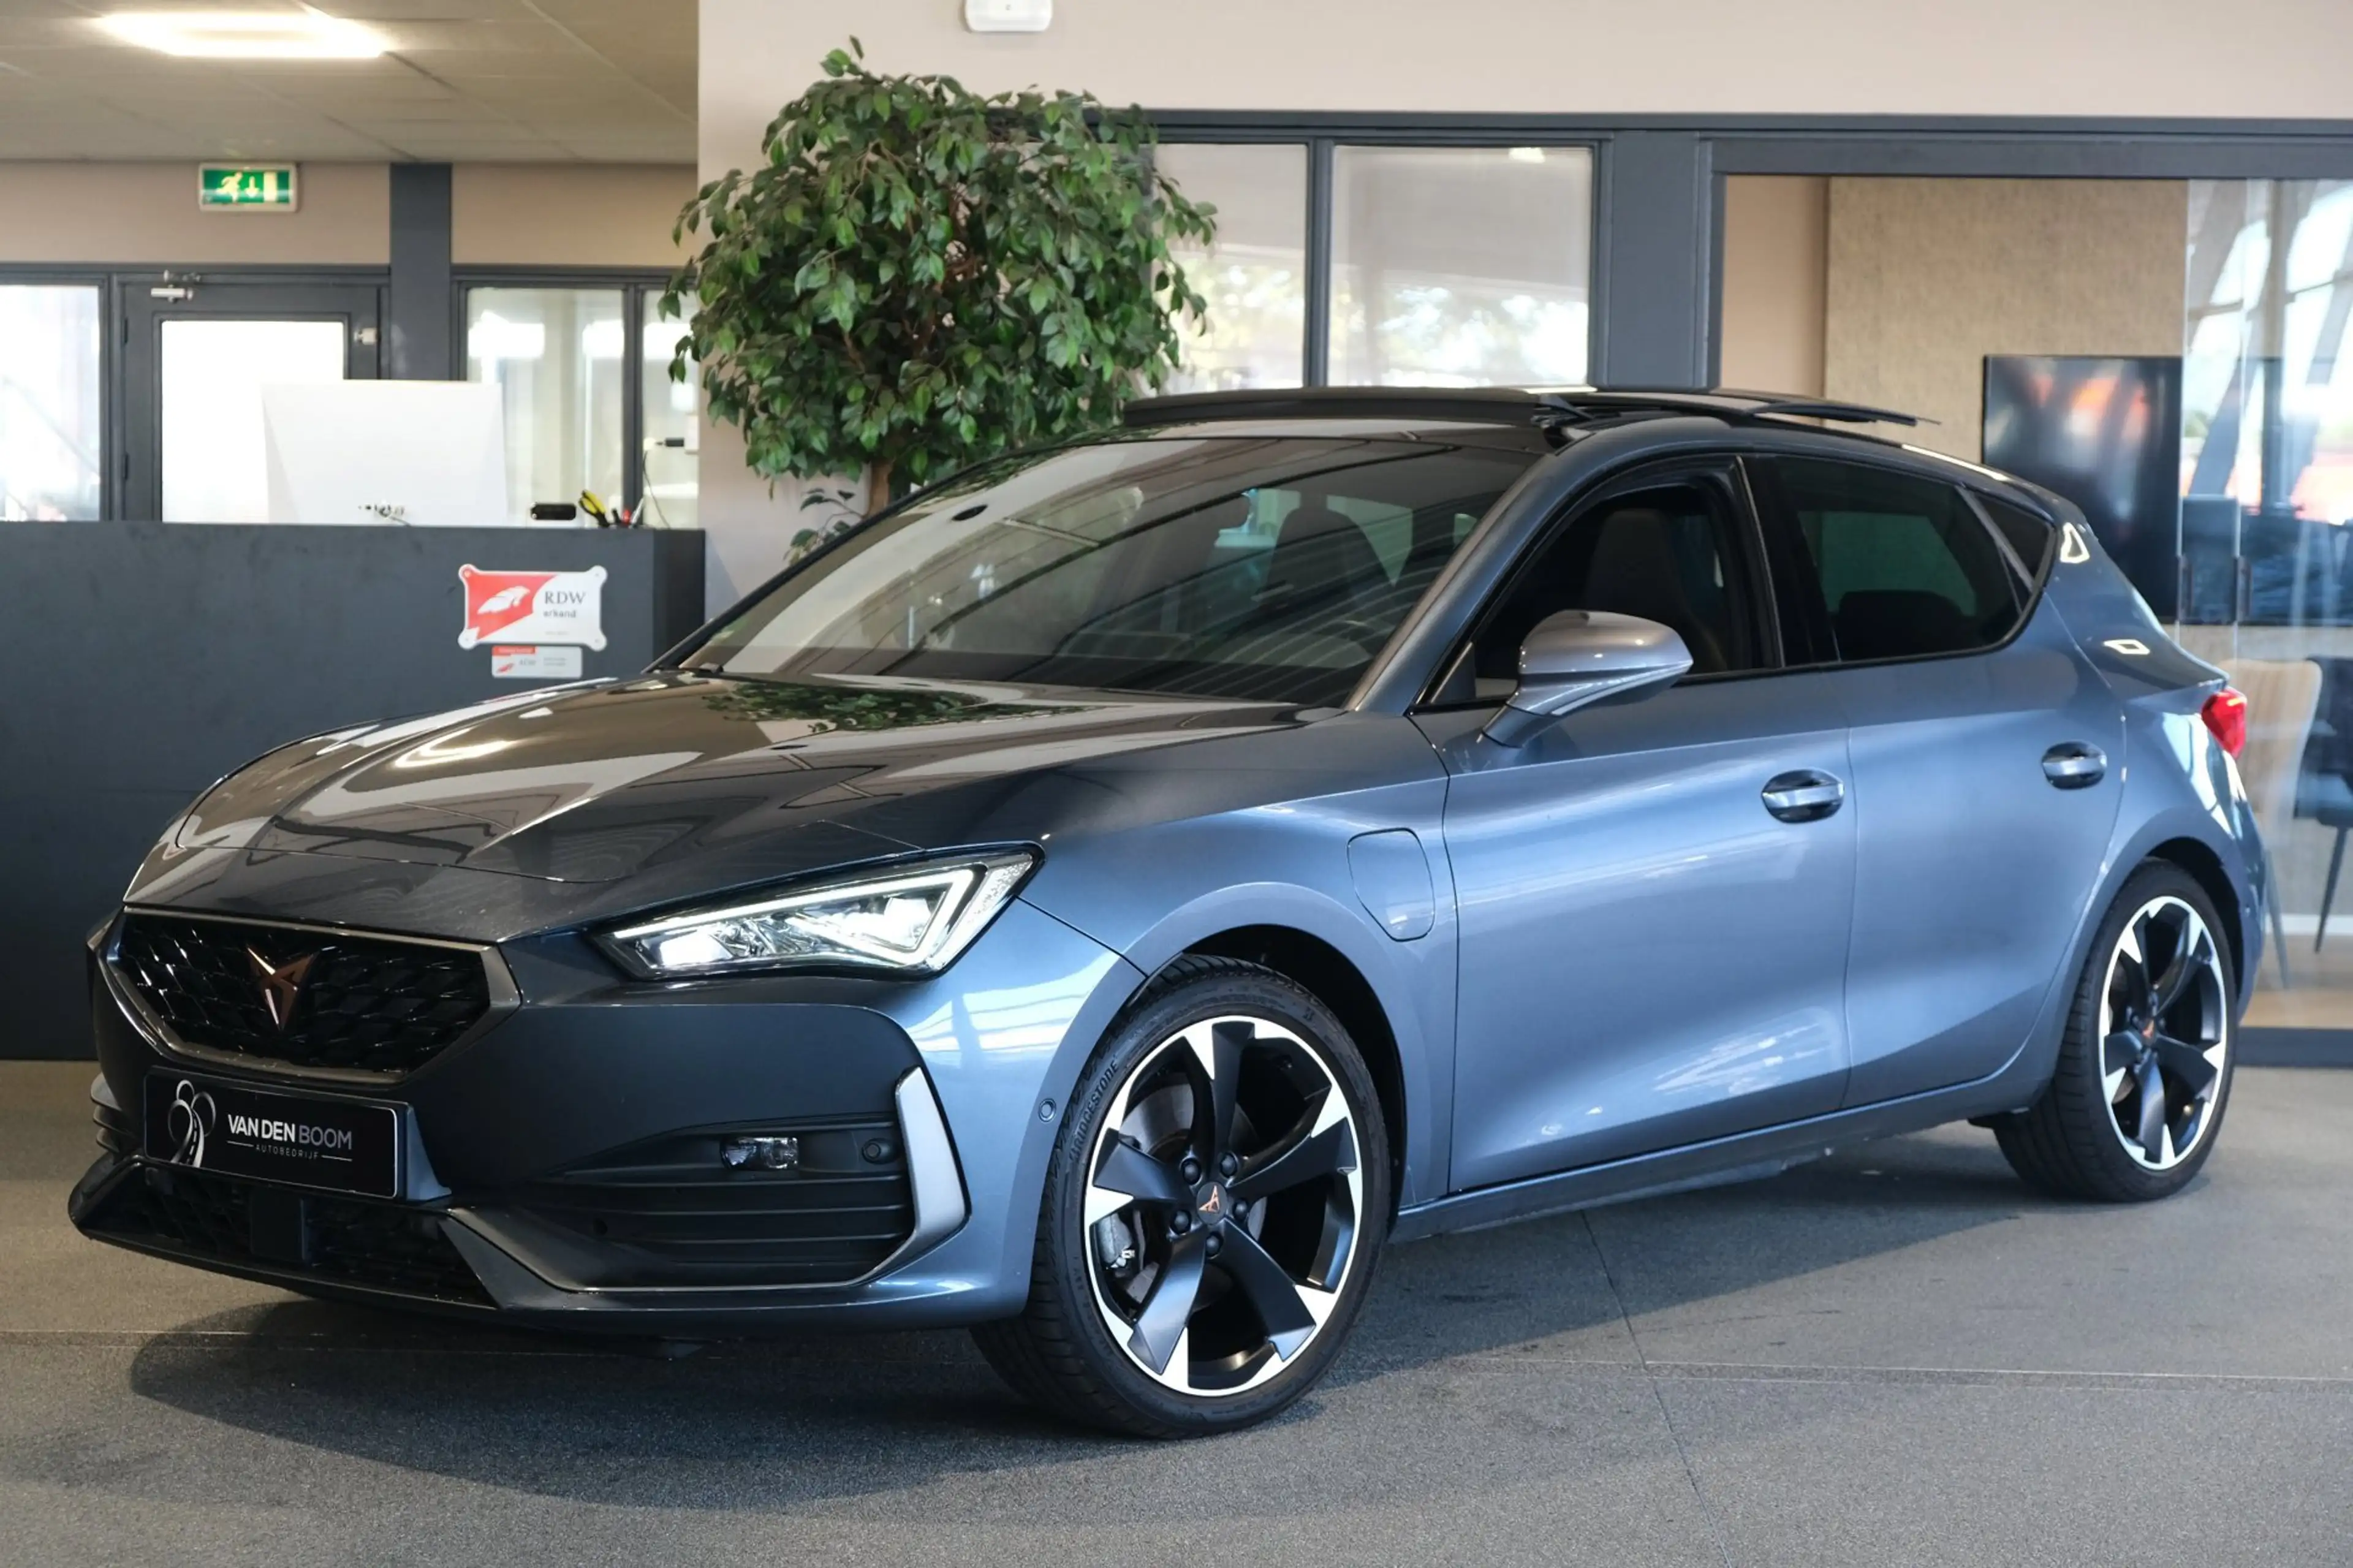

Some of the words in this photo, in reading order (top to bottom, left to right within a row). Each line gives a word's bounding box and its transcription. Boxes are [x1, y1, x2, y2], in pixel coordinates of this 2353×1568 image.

[545, 591, 586, 604] RDW
[227, 1114, 259, 1137] VAN
[261, 1119, 295, 1143] DEN
[299, 1125, 352, 1150] BOOM
[256, 1144, 319, 1159] AUTOBEDRIJF
